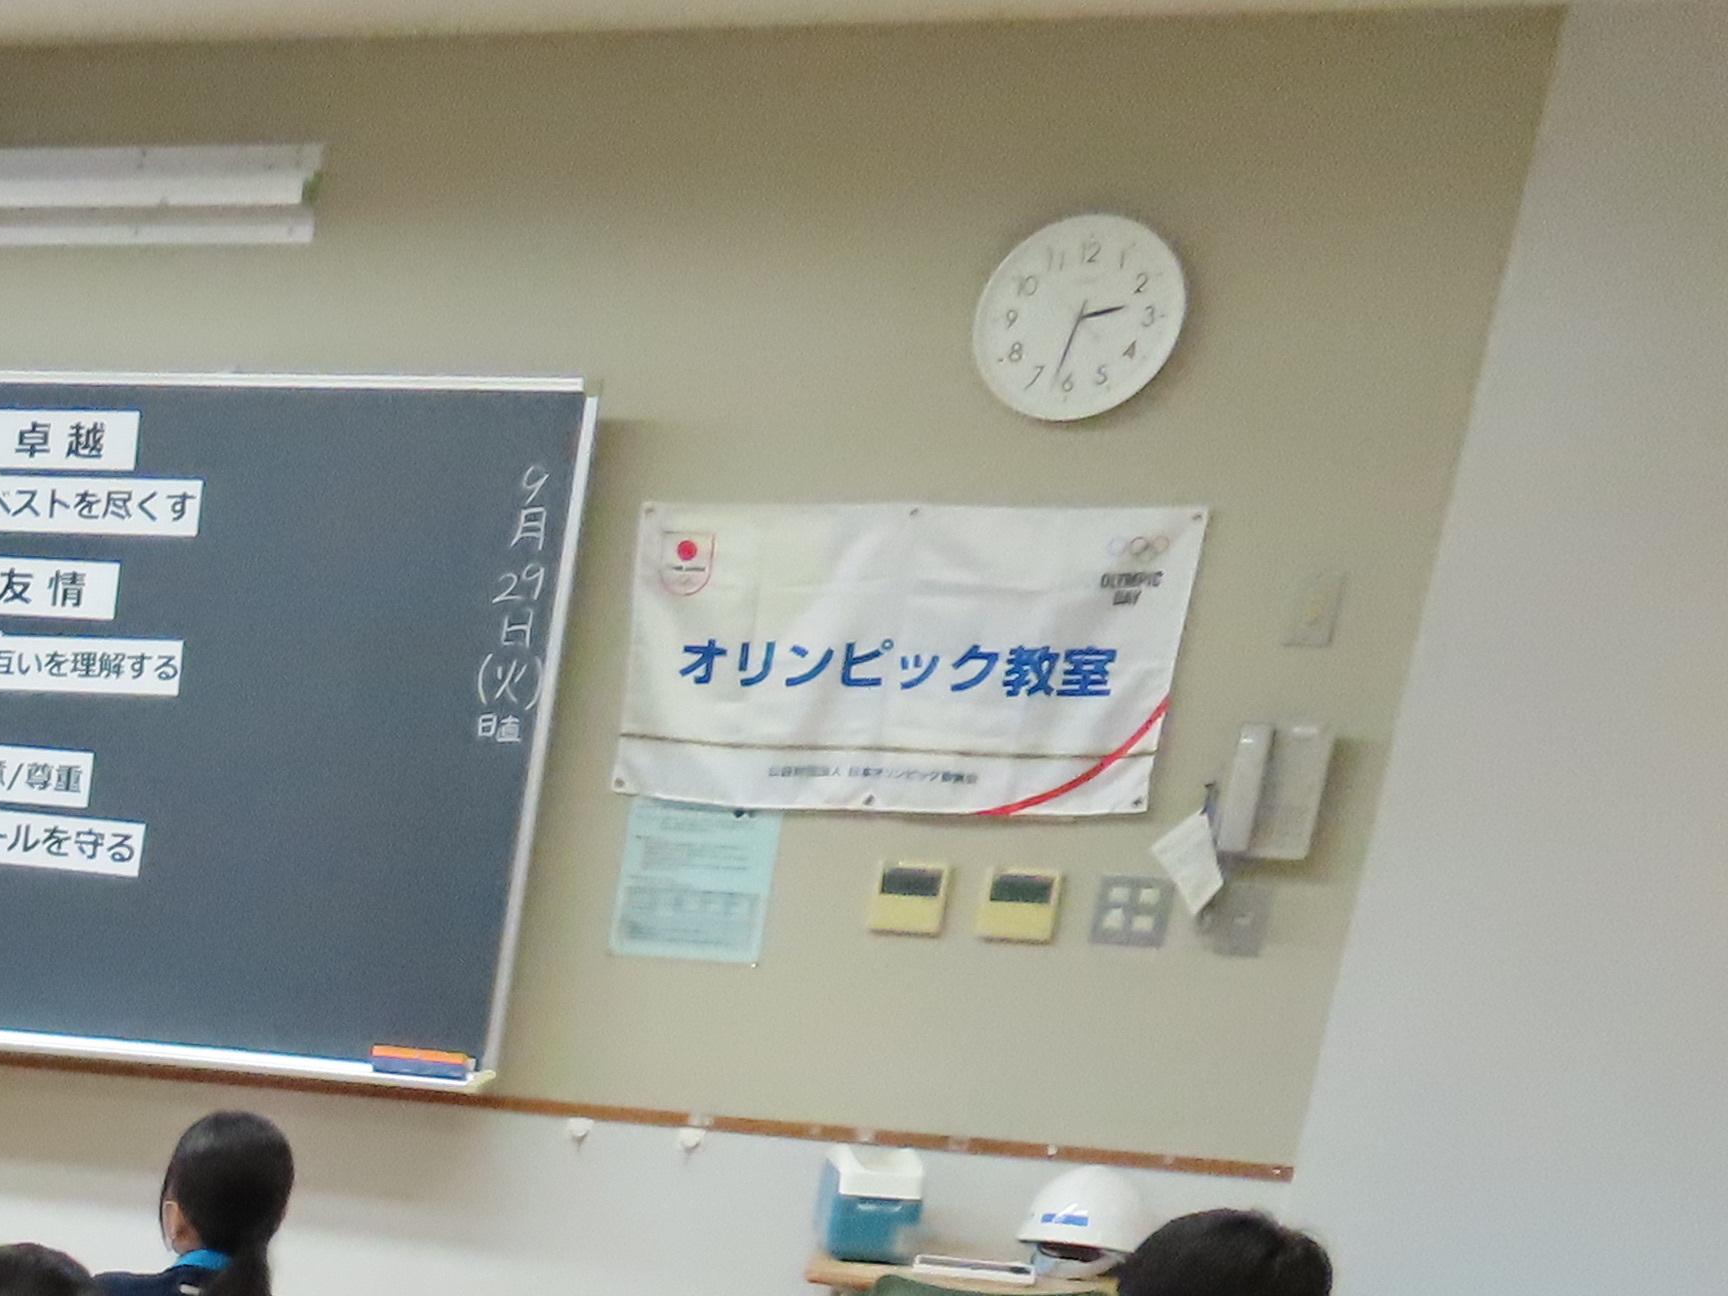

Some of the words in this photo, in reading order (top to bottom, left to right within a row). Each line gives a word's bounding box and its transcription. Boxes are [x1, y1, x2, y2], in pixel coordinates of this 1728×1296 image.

[1046, 247, 1064, 271] 11
[1081, 241, 1102, 263] 12
[1118, 250, 1126, 268] 1
[1016, 276, 1038, 297] 10
[1133, 273, 1148, 294] 2
[1006, 310, 1019, 329] 9
[1142, 306, 1155, 327] 3
[1009, 342, 1024, 362] 8
[1122, 339, 1137, 359] 4
[1024, 365, 1045, 390] 7
[1062, 373, 1074, 392] 6
[1096, 368, 1108, 385] 5
[679, 637, 1117, 697] オリンピック教室
[477, 713, 521, 743] 日直
